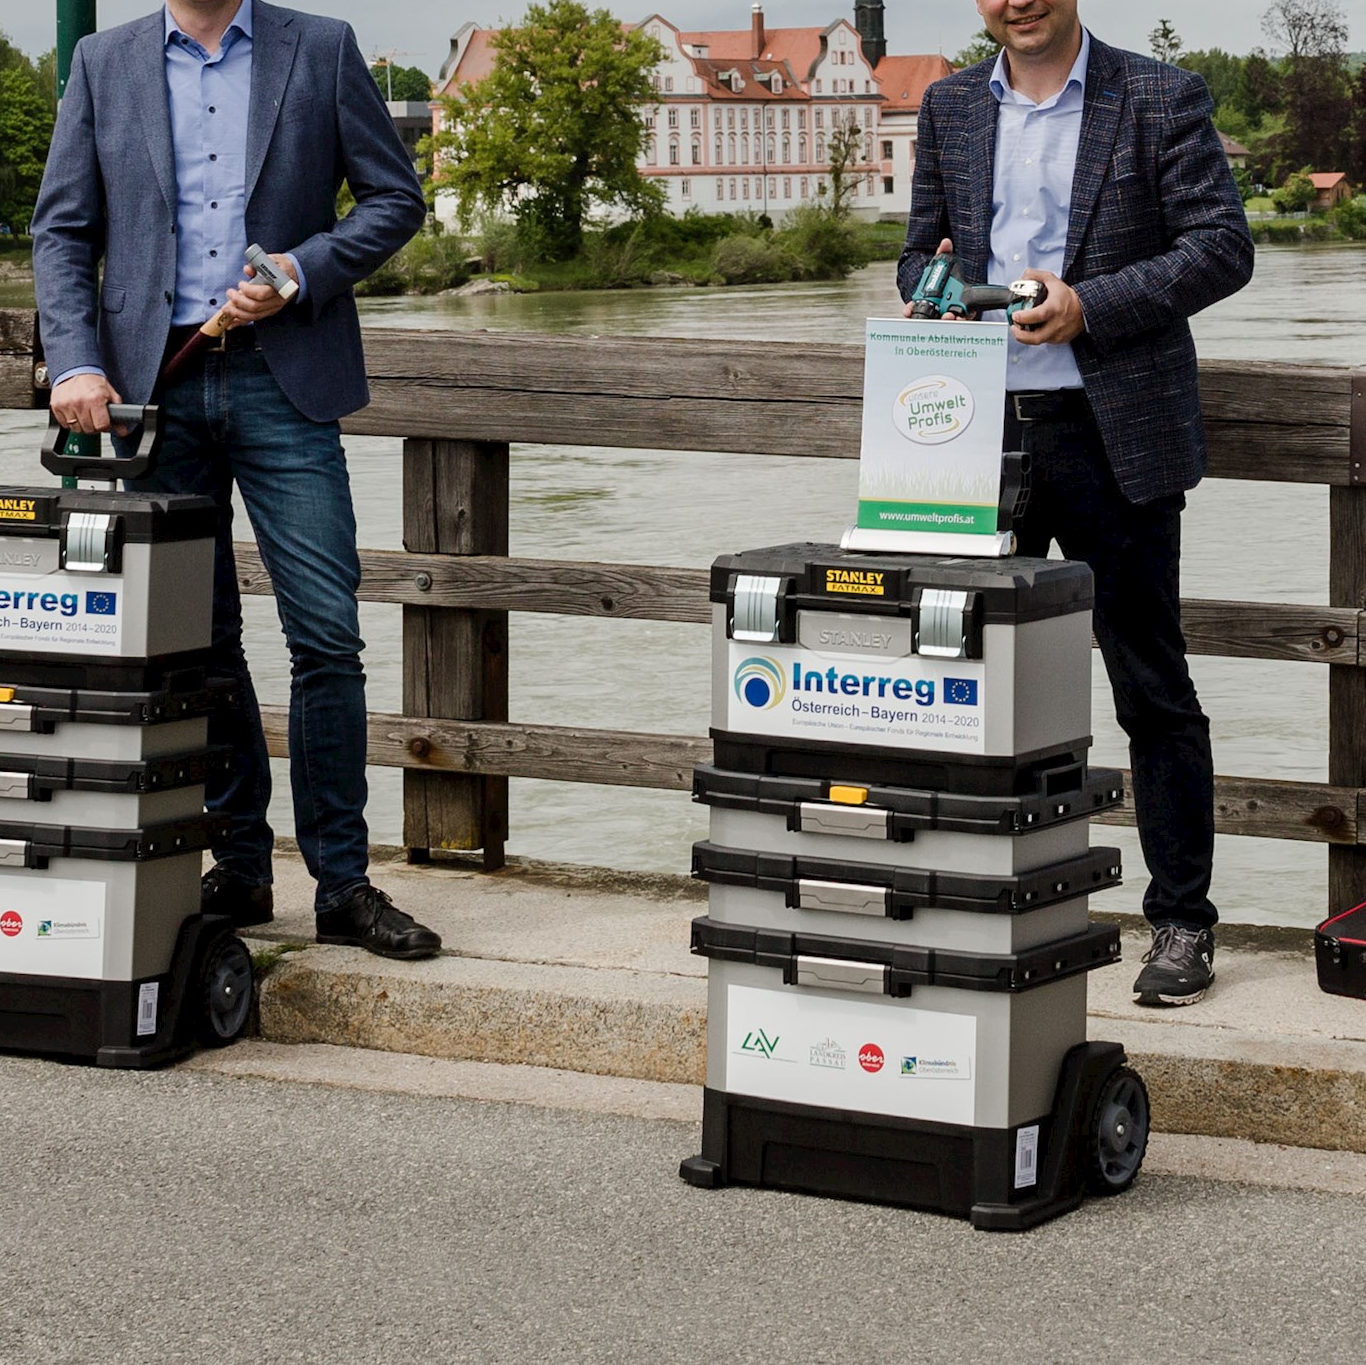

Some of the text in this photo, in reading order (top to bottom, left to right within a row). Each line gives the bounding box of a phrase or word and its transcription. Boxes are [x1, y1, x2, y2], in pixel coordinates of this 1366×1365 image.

[870, 332, 1004, 346] Kommunale Abfallwirtschaft
[907, 347, 978, 359] Oberösterreich
[910, 394, 966, 415] Umwelt
[908, 412, 953, 430] Profis
[879, 510, 975, 525] www.umweltprofis.at
[826, 569, 884, 585] STANLEY
[832, 584, 877, 594] FATMAX
[819, 629, 893, 650] STANLEY
[792, 662, 935, 706] Interreg
